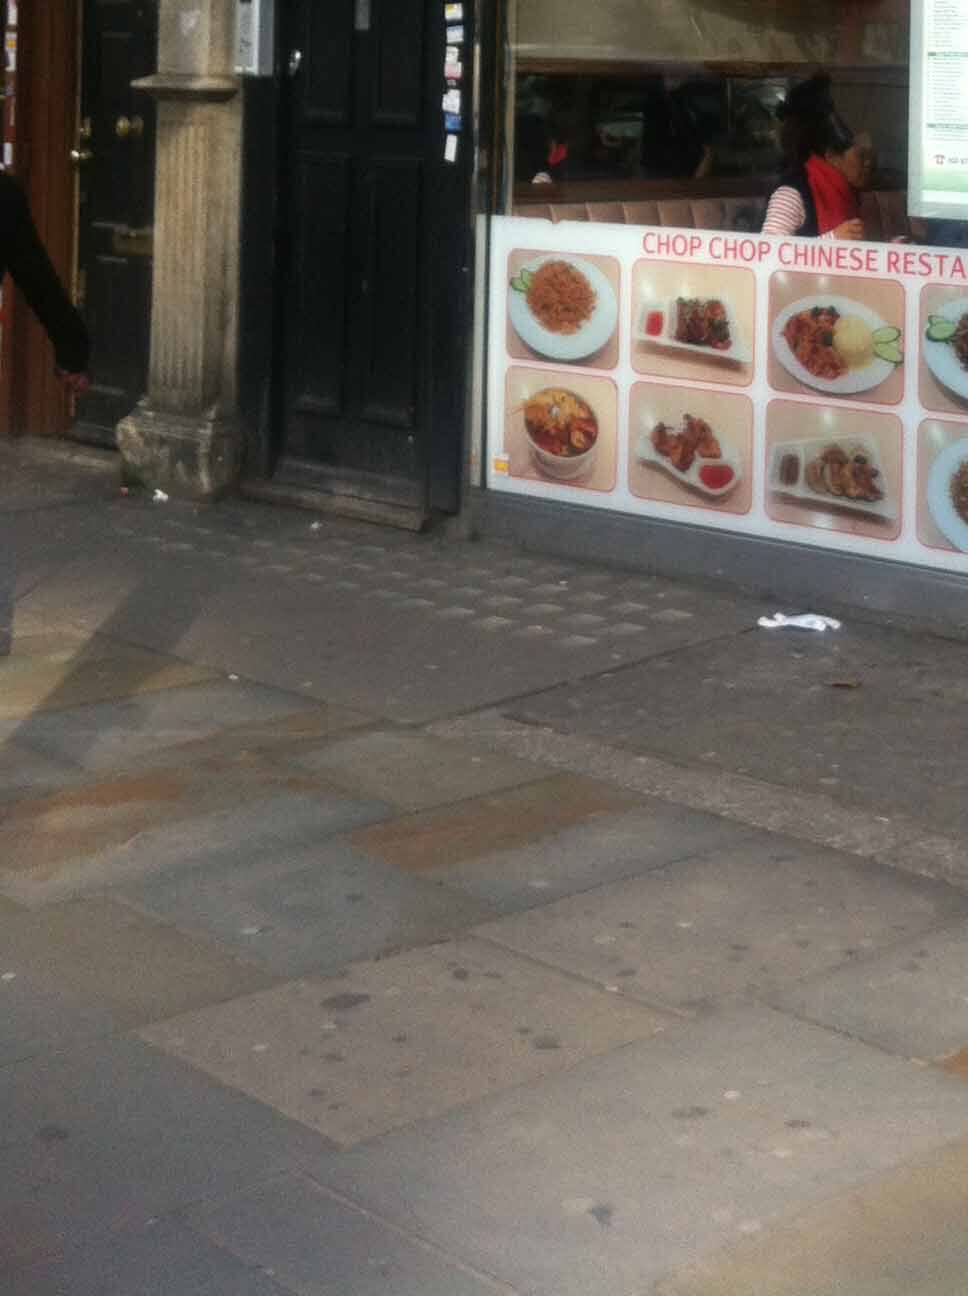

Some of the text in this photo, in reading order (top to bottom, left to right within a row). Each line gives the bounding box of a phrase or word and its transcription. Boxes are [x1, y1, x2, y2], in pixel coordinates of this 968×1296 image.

[642, 232, 703, 259] CHOP
[708, 236, 771, 264] CHOP
[778, 242, 878, 272] CHINESE
